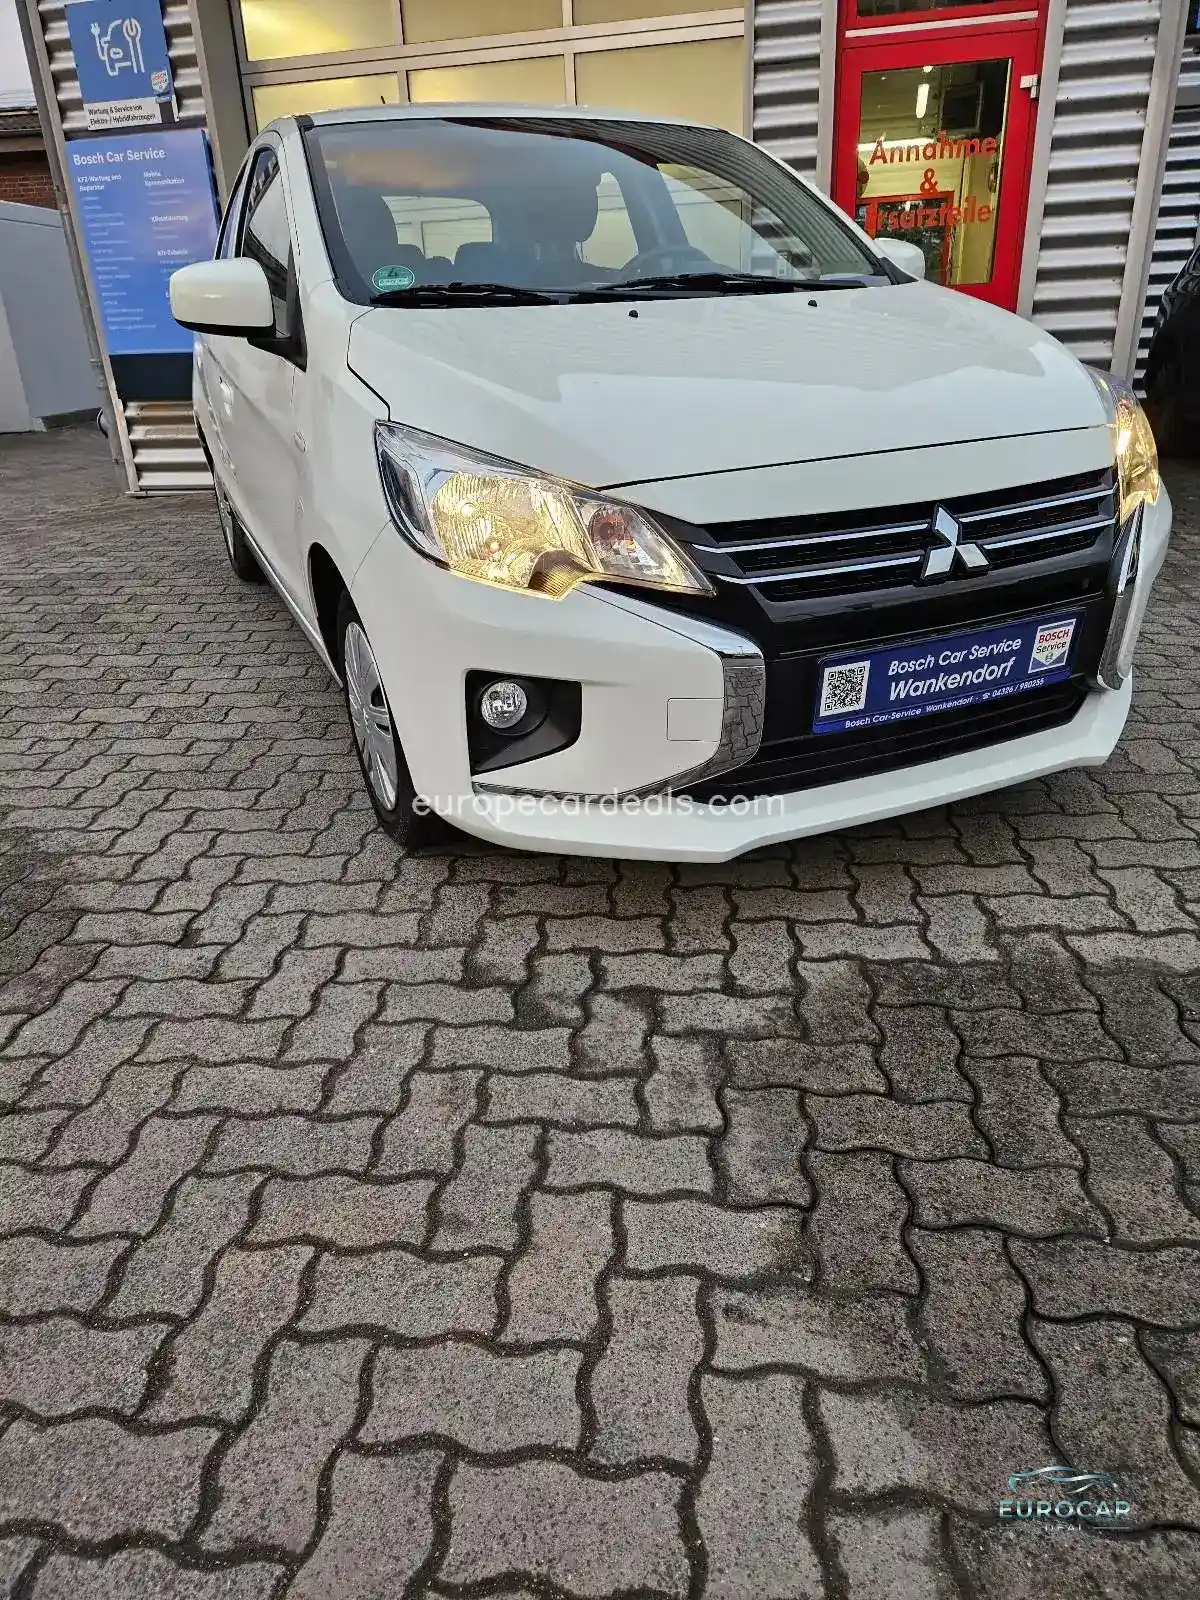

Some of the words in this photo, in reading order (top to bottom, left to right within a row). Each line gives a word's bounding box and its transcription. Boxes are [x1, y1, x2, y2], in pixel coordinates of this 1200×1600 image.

[114, 105, 133, 113] Service
[73, 152, 105, 166] Bosch
[106, 150, 125, 163] Car
[127, 147, 166, 161] Service
[869, 129, 997, 165] Annahme
[920, 168, 938, 194] &
[1036, 641, 1067, 654] Service
[1038, 628, 1070, 644] BOSCH
[888, 654, 935, 676] Bosch
[938, 649, 969, 666] Car
[968, 637, 1022, 660] Service
[889, 656, 1017, 701] Wankendorf
[844, 717, 871, 729] Bosch
[872, 707, 922, 724] Car-Service
[926, 696, 974, 713] Wankendorf
[992, 685, 1014, 698] 04326
[1019, 678, 1045, 691] 980255
